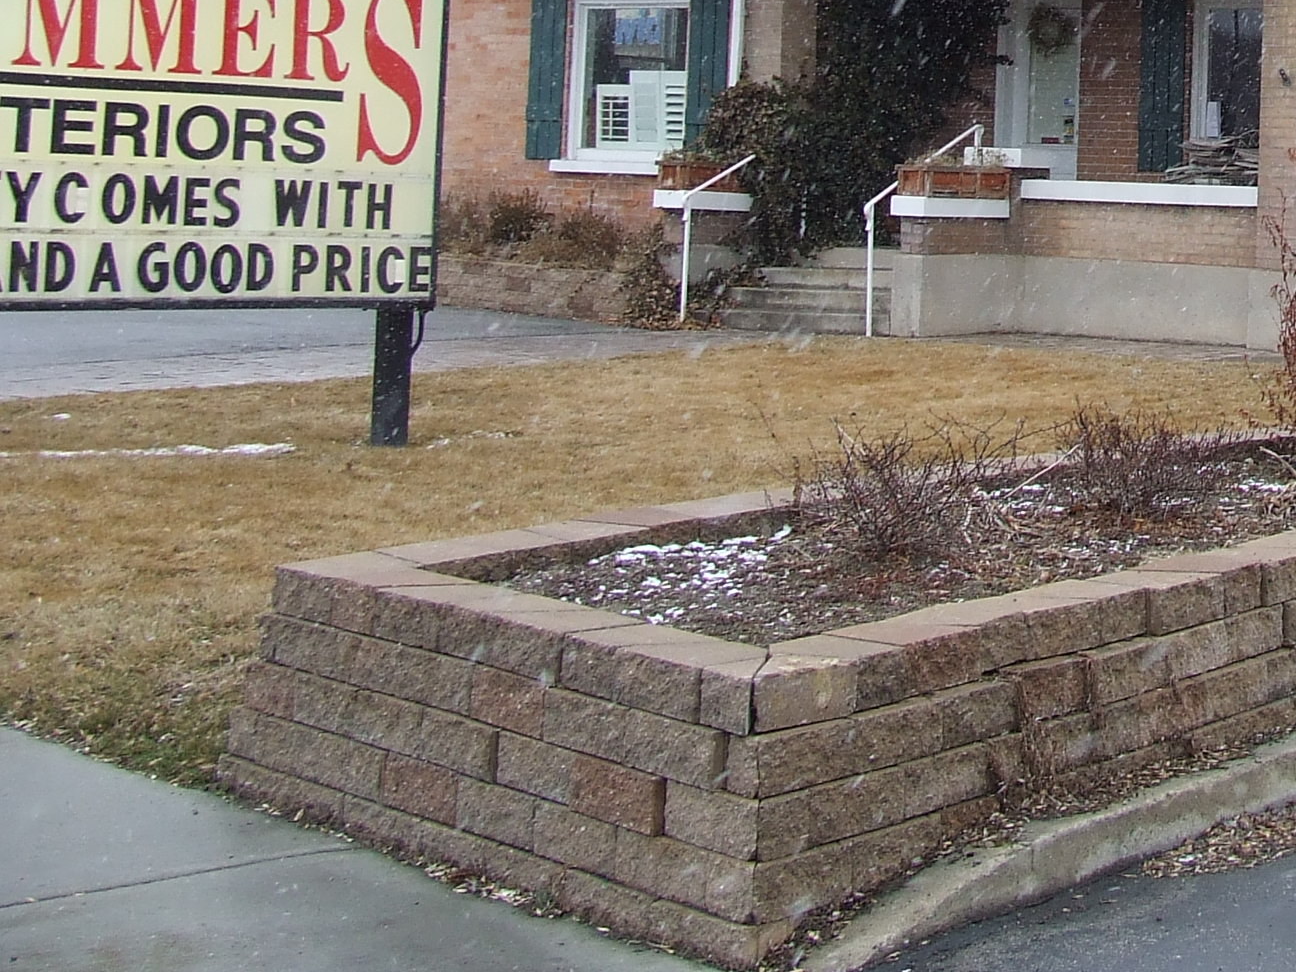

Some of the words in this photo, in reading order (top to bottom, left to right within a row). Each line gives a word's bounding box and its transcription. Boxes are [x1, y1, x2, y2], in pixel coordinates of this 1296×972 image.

[0, 170, 42, 223] Y
[54, 172, 240, 227] COMES
[275, 179, 393, 229] WITH
[0, 241, 76, 293] ND
[88, 242, 122, 293] A
[137, 241, 274, 294] GOOD
[291, 244, 432, 294] PRICE
